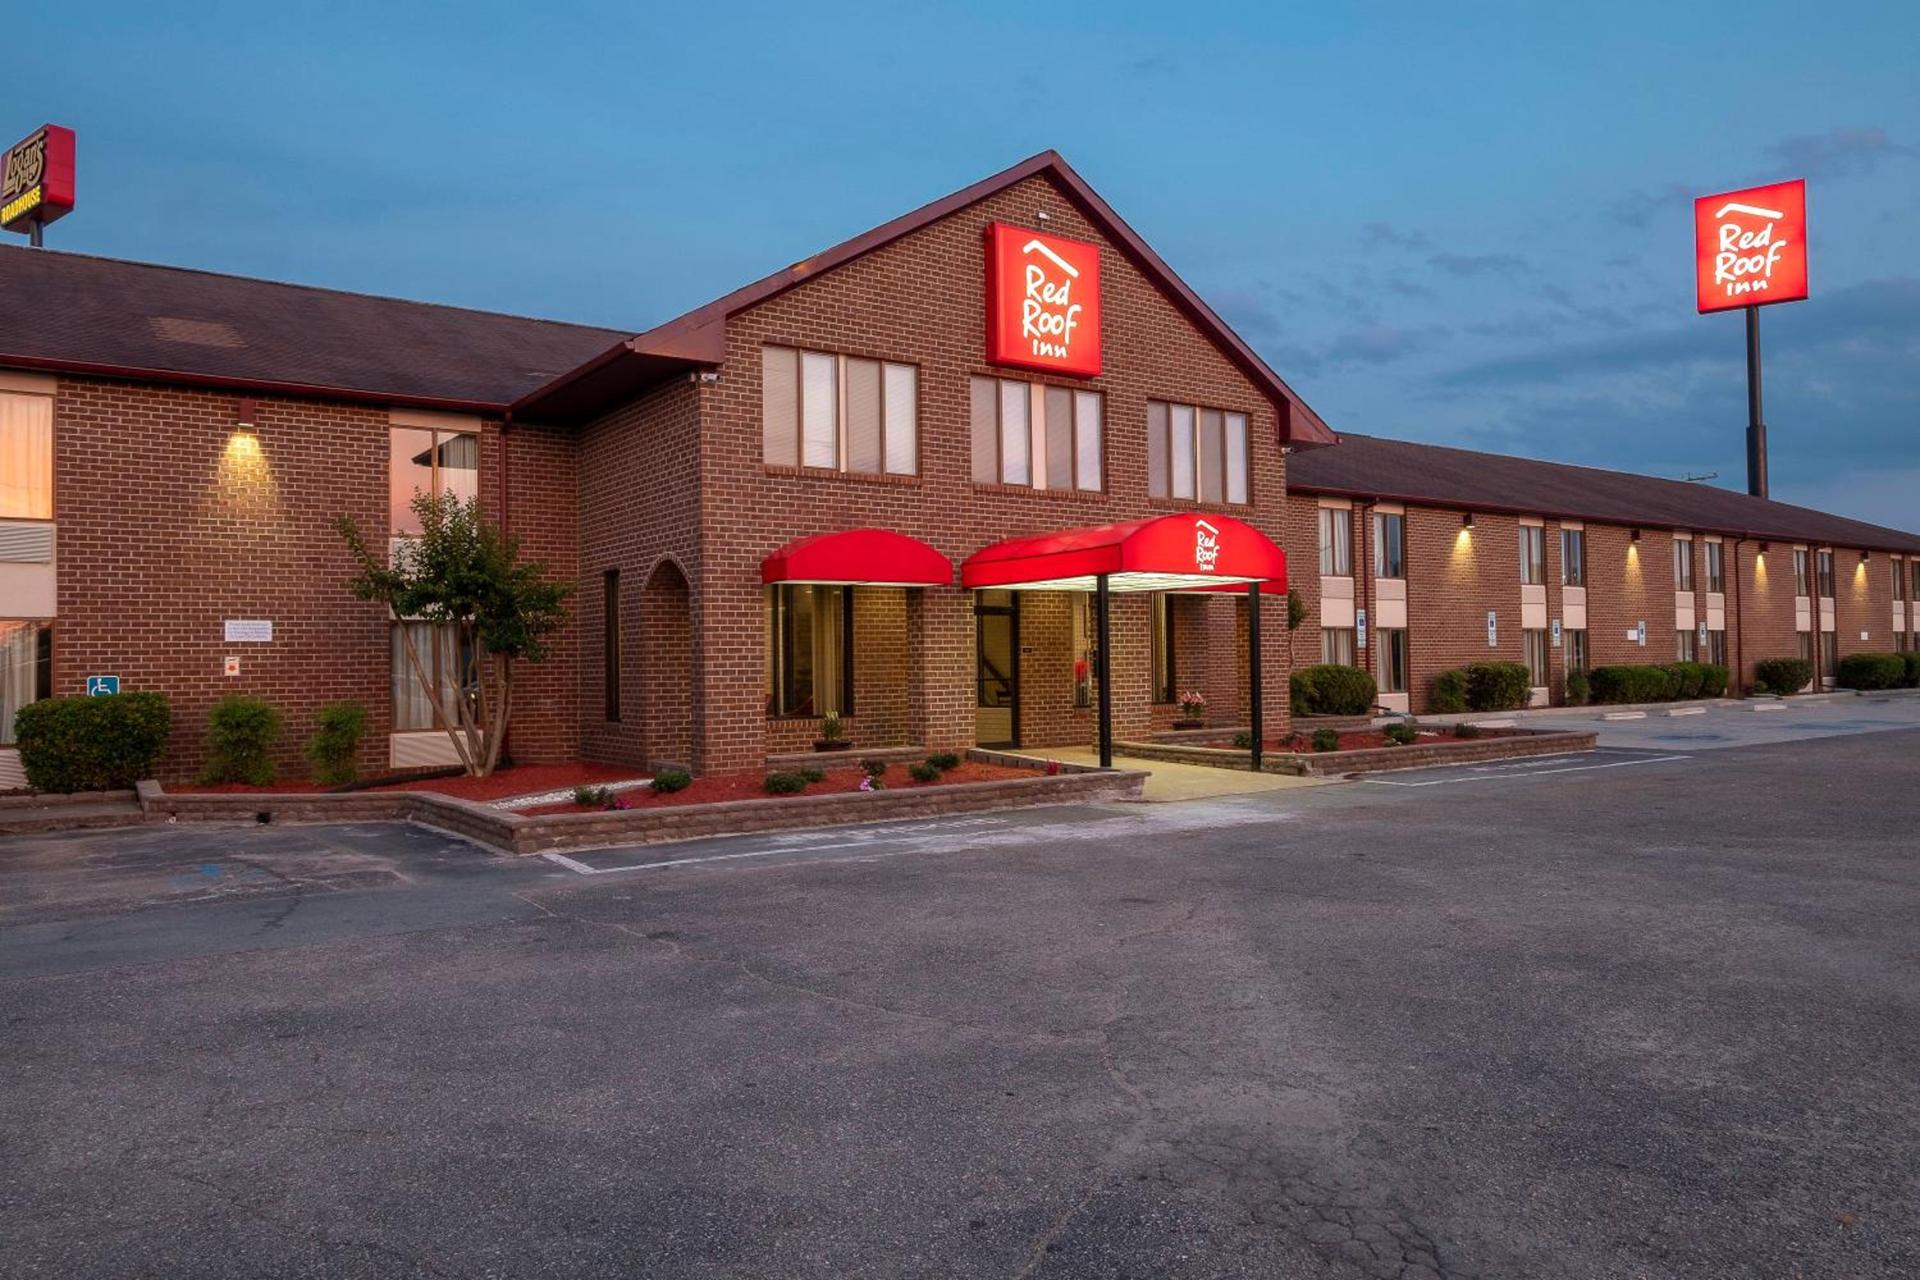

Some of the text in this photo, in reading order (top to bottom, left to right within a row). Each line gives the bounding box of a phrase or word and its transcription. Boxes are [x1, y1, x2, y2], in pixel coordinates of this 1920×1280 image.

[1719, 222, 1774, 252] Red
[1715, 240, 1787, 285] Roof
[1026, 264, 1071, 305] Red
[1023, 299, 1082, 344] Roof
[1196, 545, 1220, 564] Roof
[1197, 531, 1216, 547] Red
